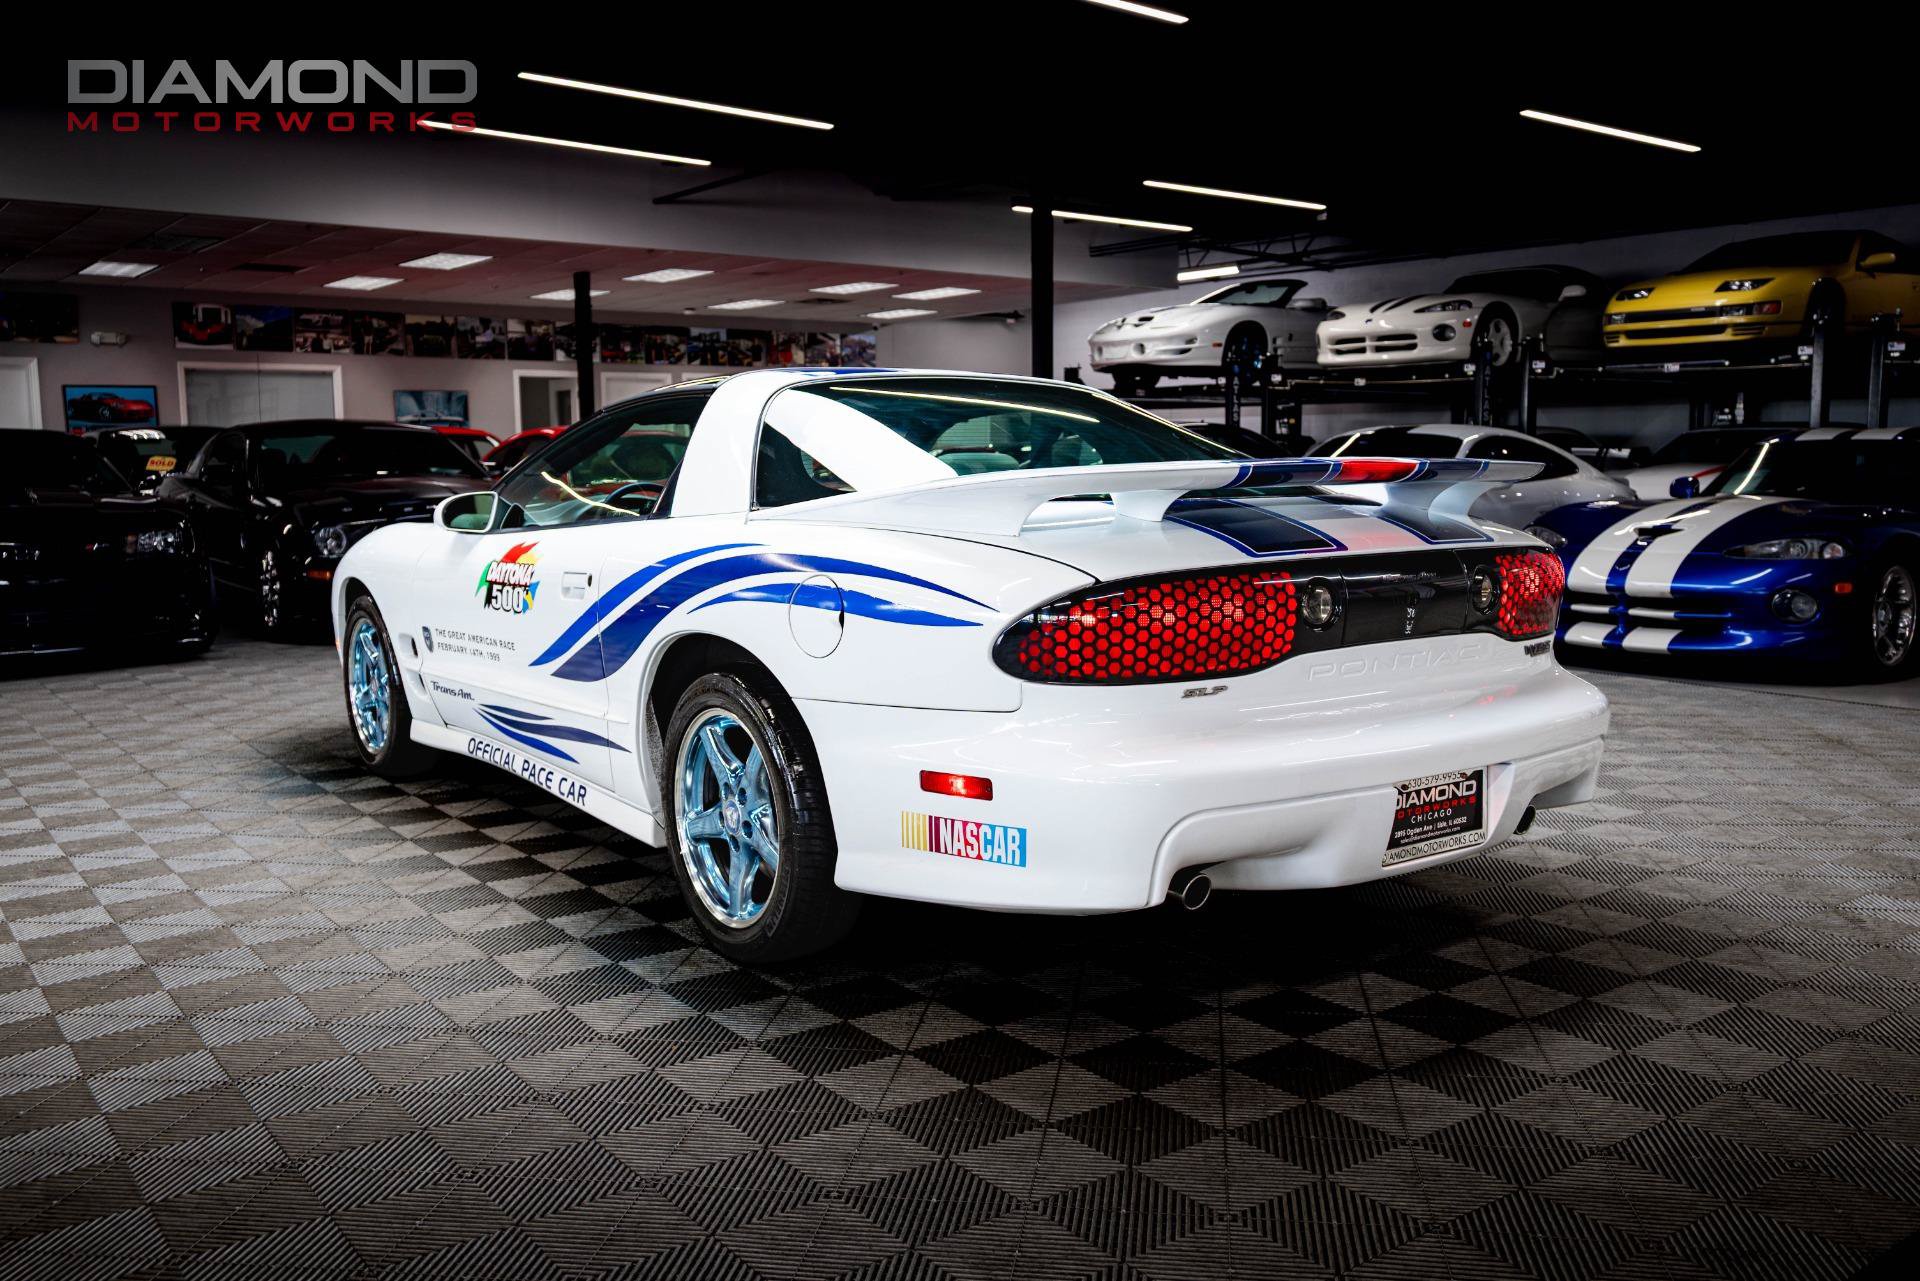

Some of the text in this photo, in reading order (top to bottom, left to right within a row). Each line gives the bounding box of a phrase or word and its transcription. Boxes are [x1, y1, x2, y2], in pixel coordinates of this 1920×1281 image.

[1232, 375, 1241, 422] ATLAS
[150, 459, 174, 467] SOLD
[486, 560, 535, 587] DAYTONA
[490, 584, 524, 613] 500
[435, 628, 516, 651] THE GREAT AMERICAN RACE
[437, 642, 468, 654] FEBRUARY
[1308, 643, 1483, 682] PONTIAC
[1181, 685, 1229, 699] SLP
[467, 737, 587, 806] OFFICIAL PACE CAR
[1396, 795, 1477, 820] OTORWORKS
[1410, 808, 1452, 824] CHICAGO
[939, 817, 1021, 866] NASCAR
